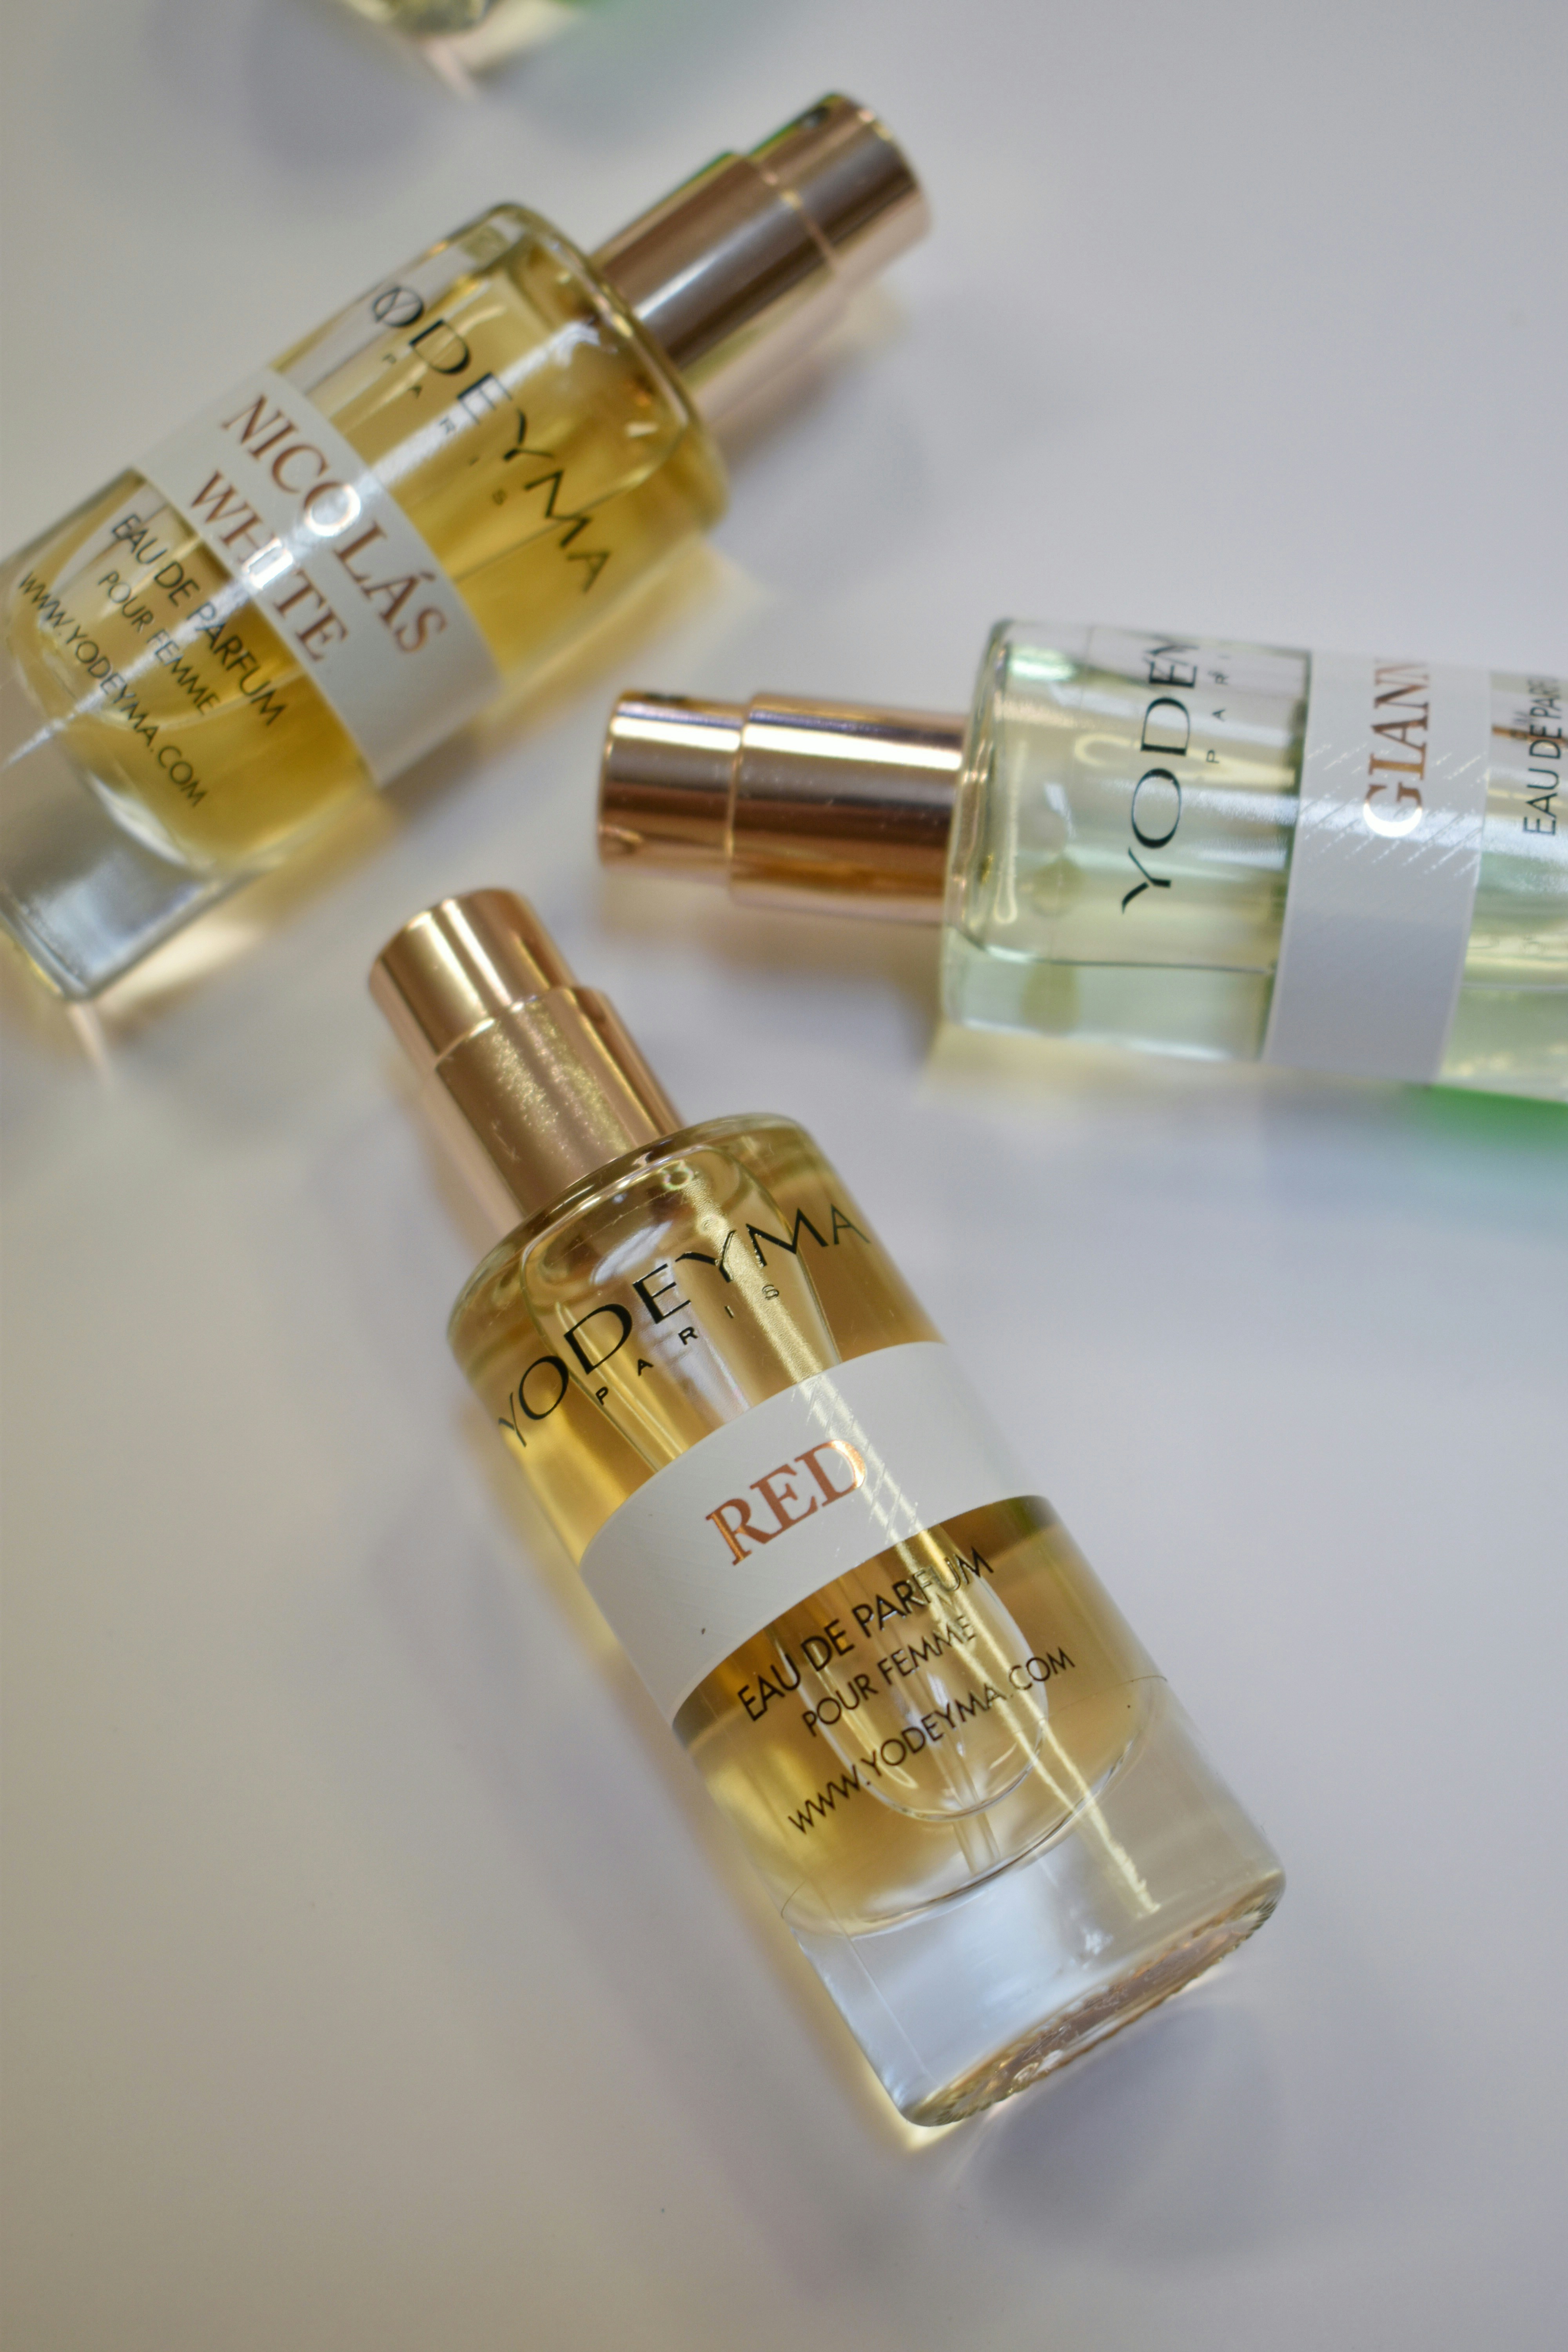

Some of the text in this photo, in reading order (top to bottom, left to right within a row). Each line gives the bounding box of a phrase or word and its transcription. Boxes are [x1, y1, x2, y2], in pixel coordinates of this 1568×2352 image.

[191, 470, 348, 661] WHITE
[221, 394, 448, 653] NICOLÁS
[18, 571, 208, 808] WWW.YODEYMA.COM
[97, 570, 221, 716] POUR FEMME
[111, 514, 287, 727] EAU DE PARFUM
[1523, 768, 1560, 835] EAU
[1528, 724, 1562, 759] DE
[498, 1203, 871, 1447] YODEYMA
[595, 1284, 779, 1405] PARIS
[705, 1439, 866, 1566] RED
[737, 1546, 995, 1722] EAU DE PARFUM
[802, 1615, 976, 1737] POUR FEMME
[788, 1647, 1076, 1835] WWW.YODEYMA.COM
